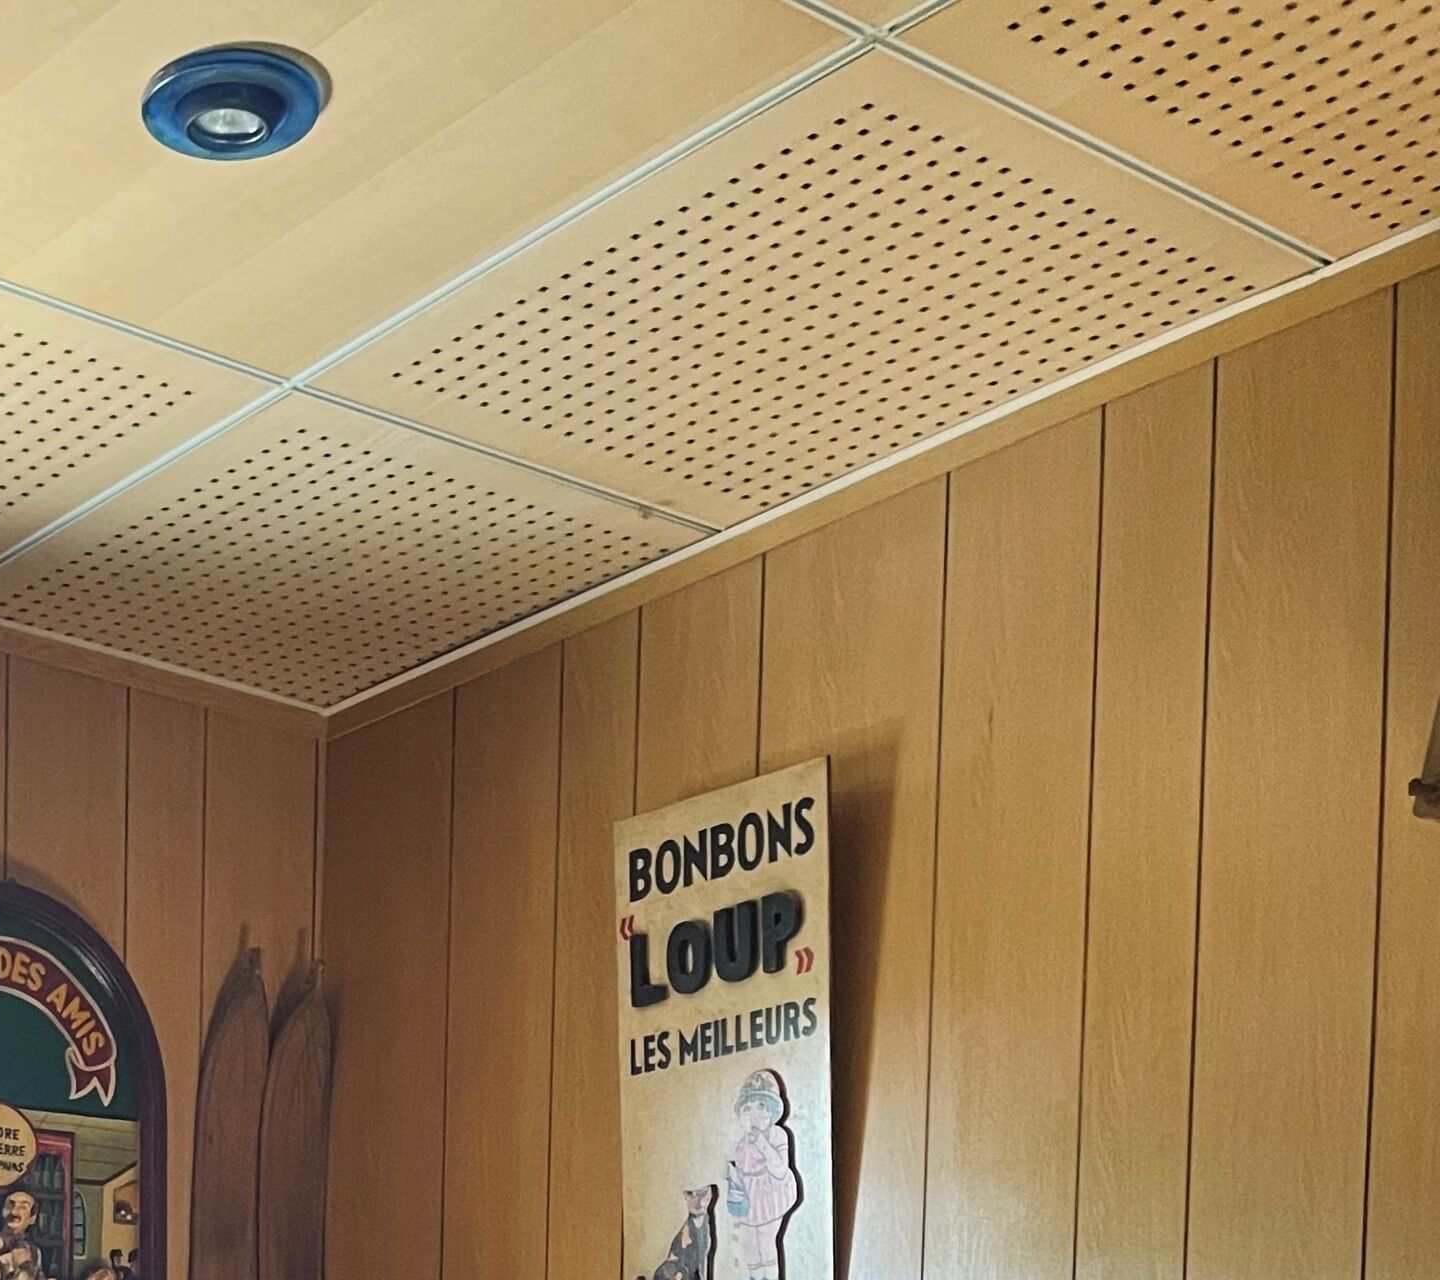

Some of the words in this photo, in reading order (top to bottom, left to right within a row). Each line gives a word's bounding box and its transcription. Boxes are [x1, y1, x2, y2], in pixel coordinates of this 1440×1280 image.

[629, 797, 814, 902] BONBONS
[46, 983, 105, 1056] AMIS
[630, 1031, 672, 1076] LES
[678, 997, 817, 1066] MEILLEURS
